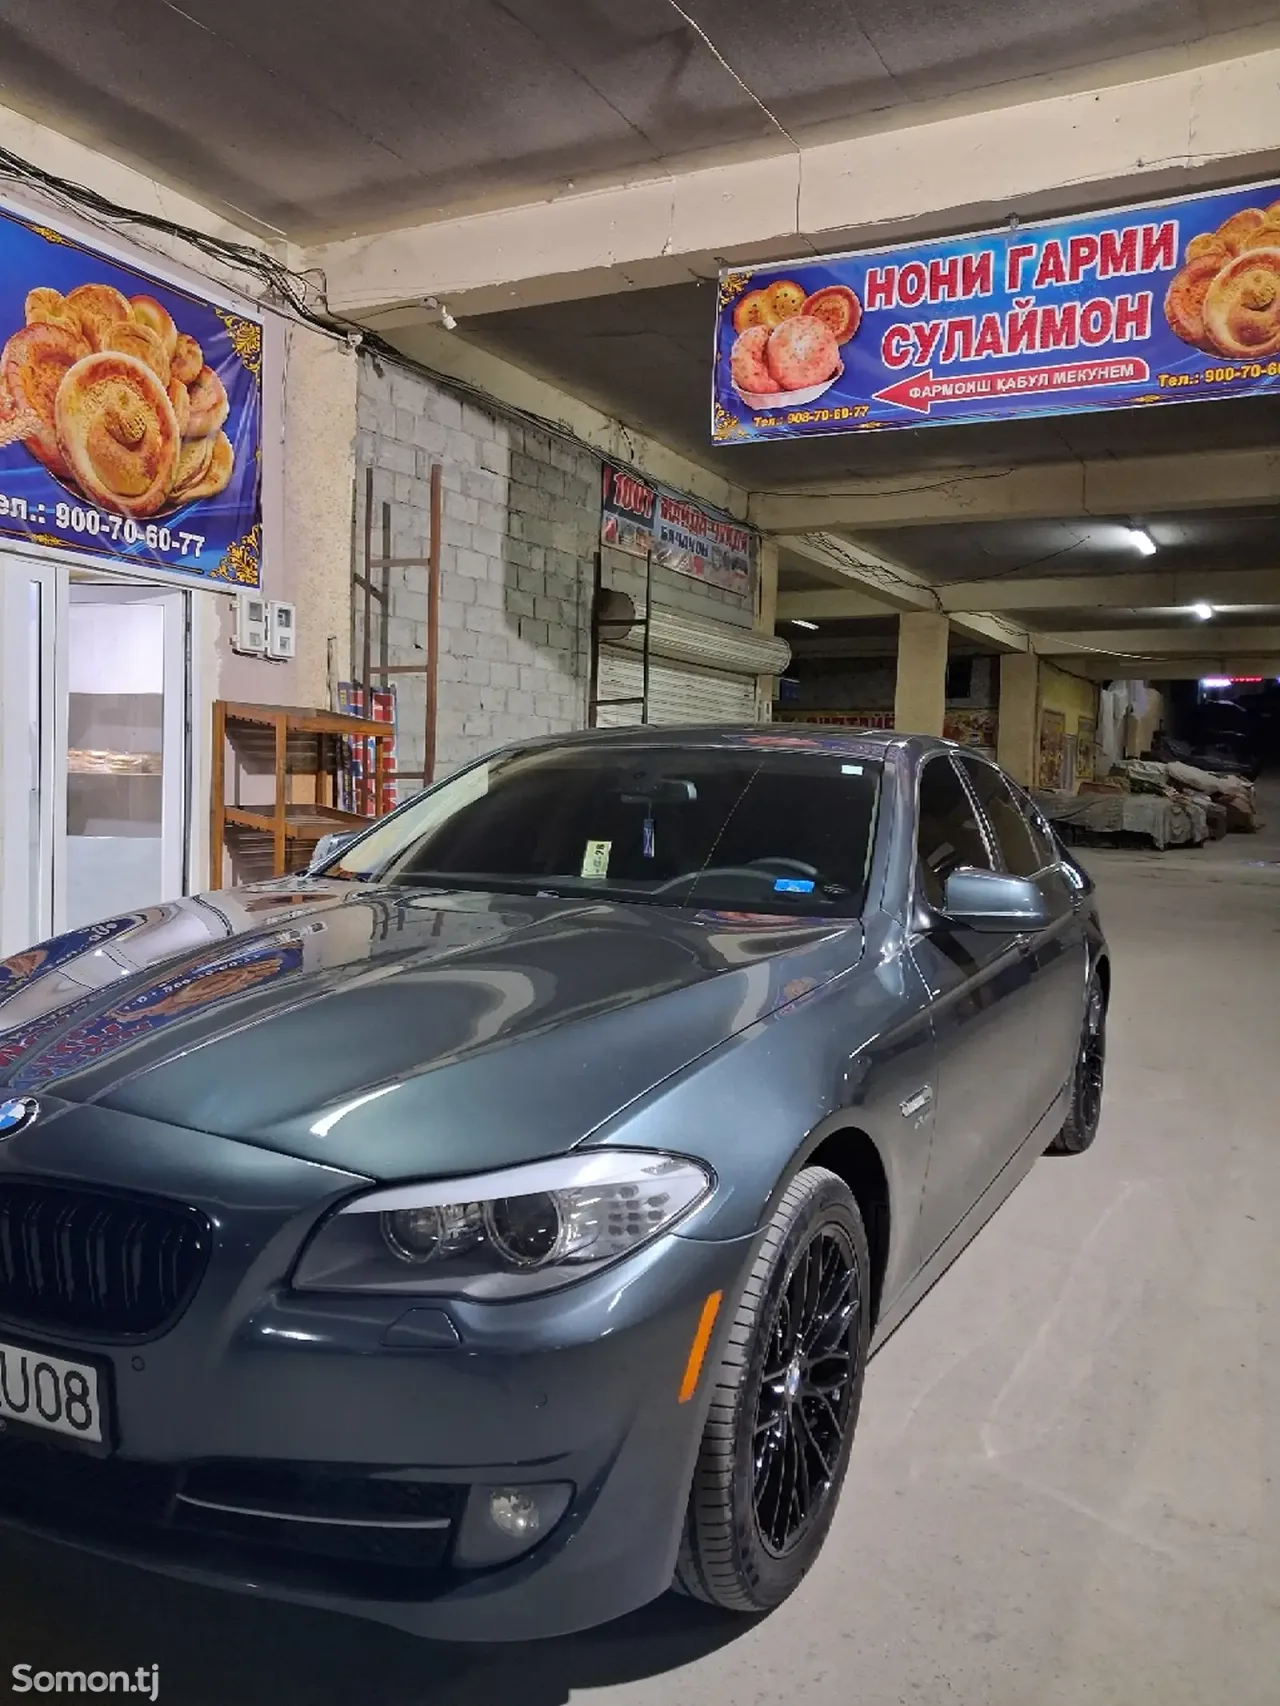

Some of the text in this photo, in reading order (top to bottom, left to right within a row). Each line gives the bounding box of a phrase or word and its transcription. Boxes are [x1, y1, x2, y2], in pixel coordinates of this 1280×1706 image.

[864, 220, 1178, 311] НОНИ ГАРМИ
[881, 290, 1153, 369] СУЛАЙМОН
[909, 380, 991, 399] ФАРМОИШ
[1052, 363, 1135, 385] МЕКУНЕМ
[1158, 373, 1200, 387] Тел.:
[55, 502, 206, 558] 900-70-60-77
[0, 1350, 92, 1431] U08
